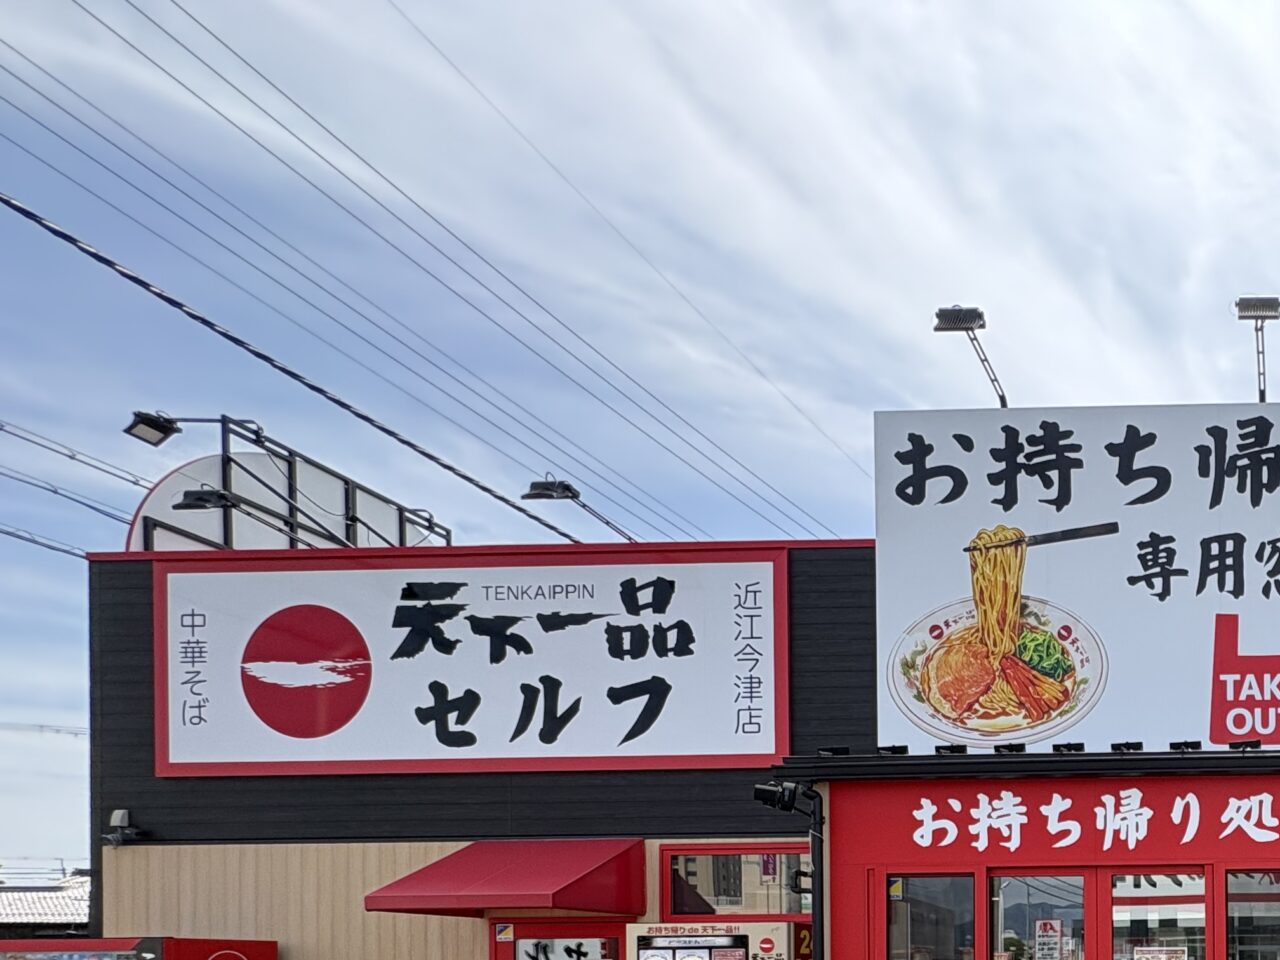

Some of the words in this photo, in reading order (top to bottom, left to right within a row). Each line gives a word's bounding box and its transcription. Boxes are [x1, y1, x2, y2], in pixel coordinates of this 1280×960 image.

[390, 576, 697, 664] 天下一品
[481, 583, 595, 601] TENKAIPPIN
[178, 608, 208, 727] 中華そば
[733, 582, 764, 736] 近江今津店
[414, 674, 673, 748] セルフ
[912, 788, 1280, 852] お持ち帰り処
